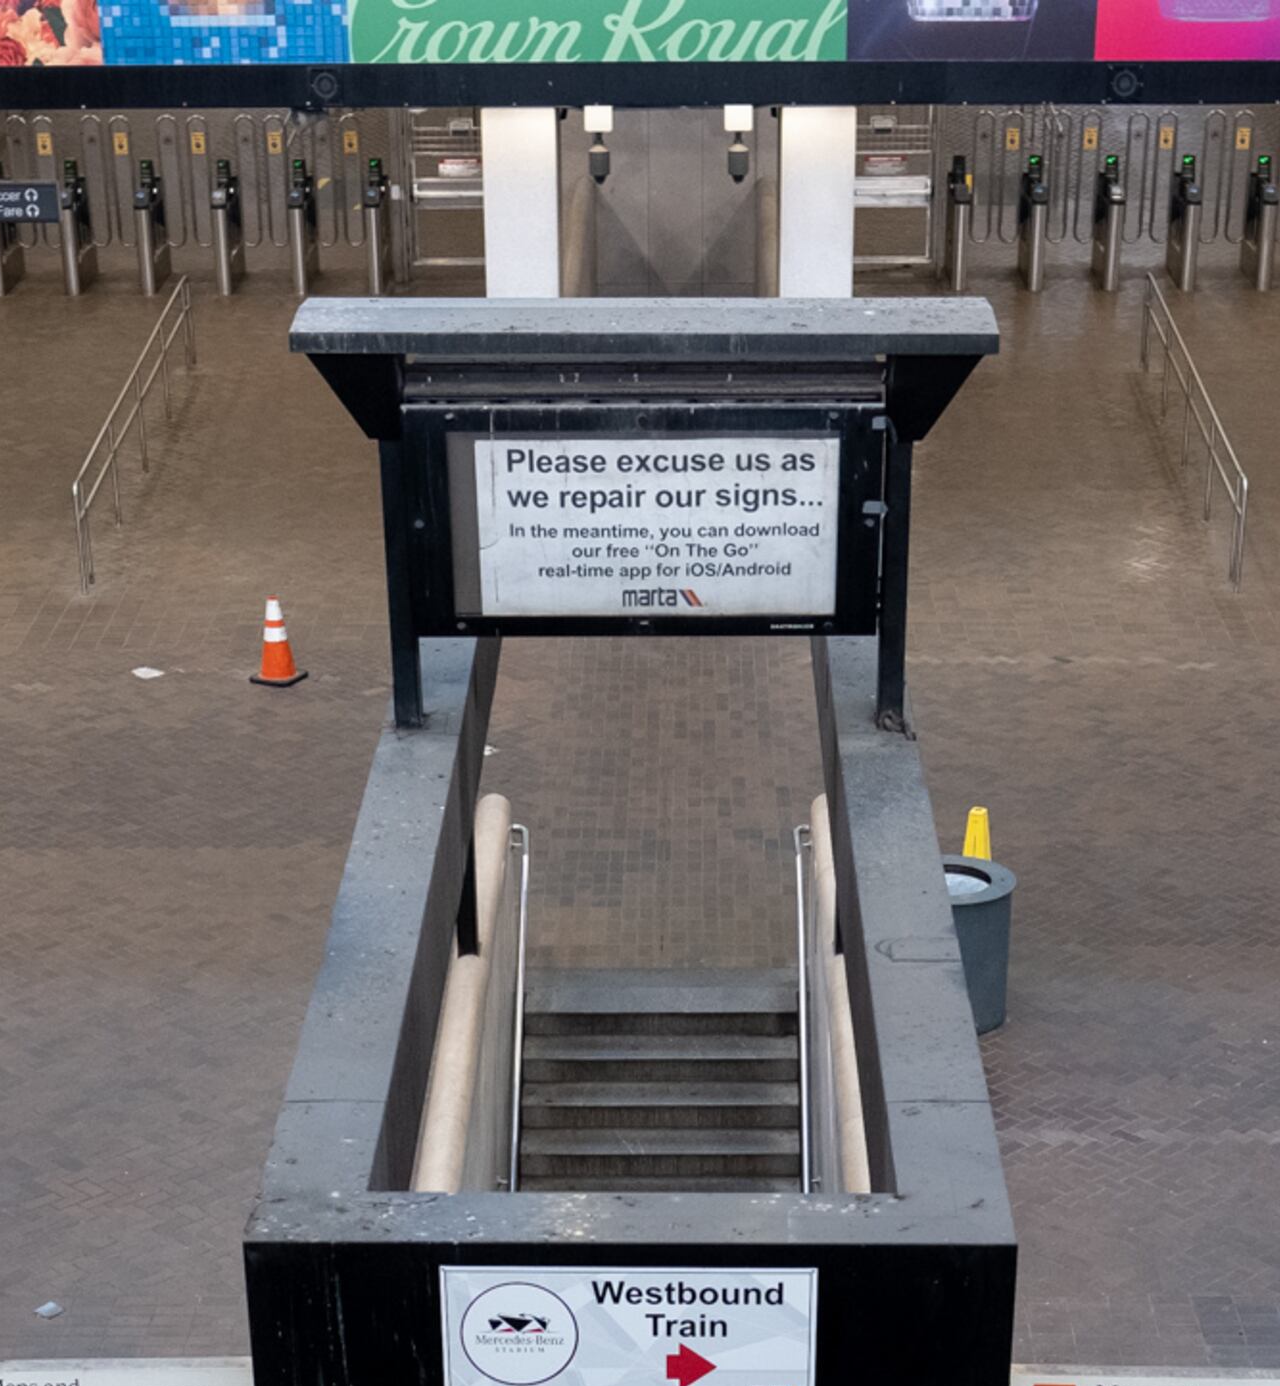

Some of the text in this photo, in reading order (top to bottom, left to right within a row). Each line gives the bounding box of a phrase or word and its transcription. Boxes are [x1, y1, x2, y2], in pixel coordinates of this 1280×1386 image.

[370, 0, 583, 62] rown
[506, 448, 816, 474] Please excuse us as
[507, 483, 824, 513] we repair our signs...
[509, 522, 820, 541] In the meantime, you can download
[572, 546, 602, 559] our
[606, 544, 640, 558] free
[686, 543, 718, 558] The
[538, 563, 792, 582] real-time app for iOS/Android
[622, 587, 677, 608] marta
[592, 1281, 784, 1306] Westbound
[645, 1313, 728, 1338] Train
[475, 1333, 564, 1347] Mercedes-Benz
